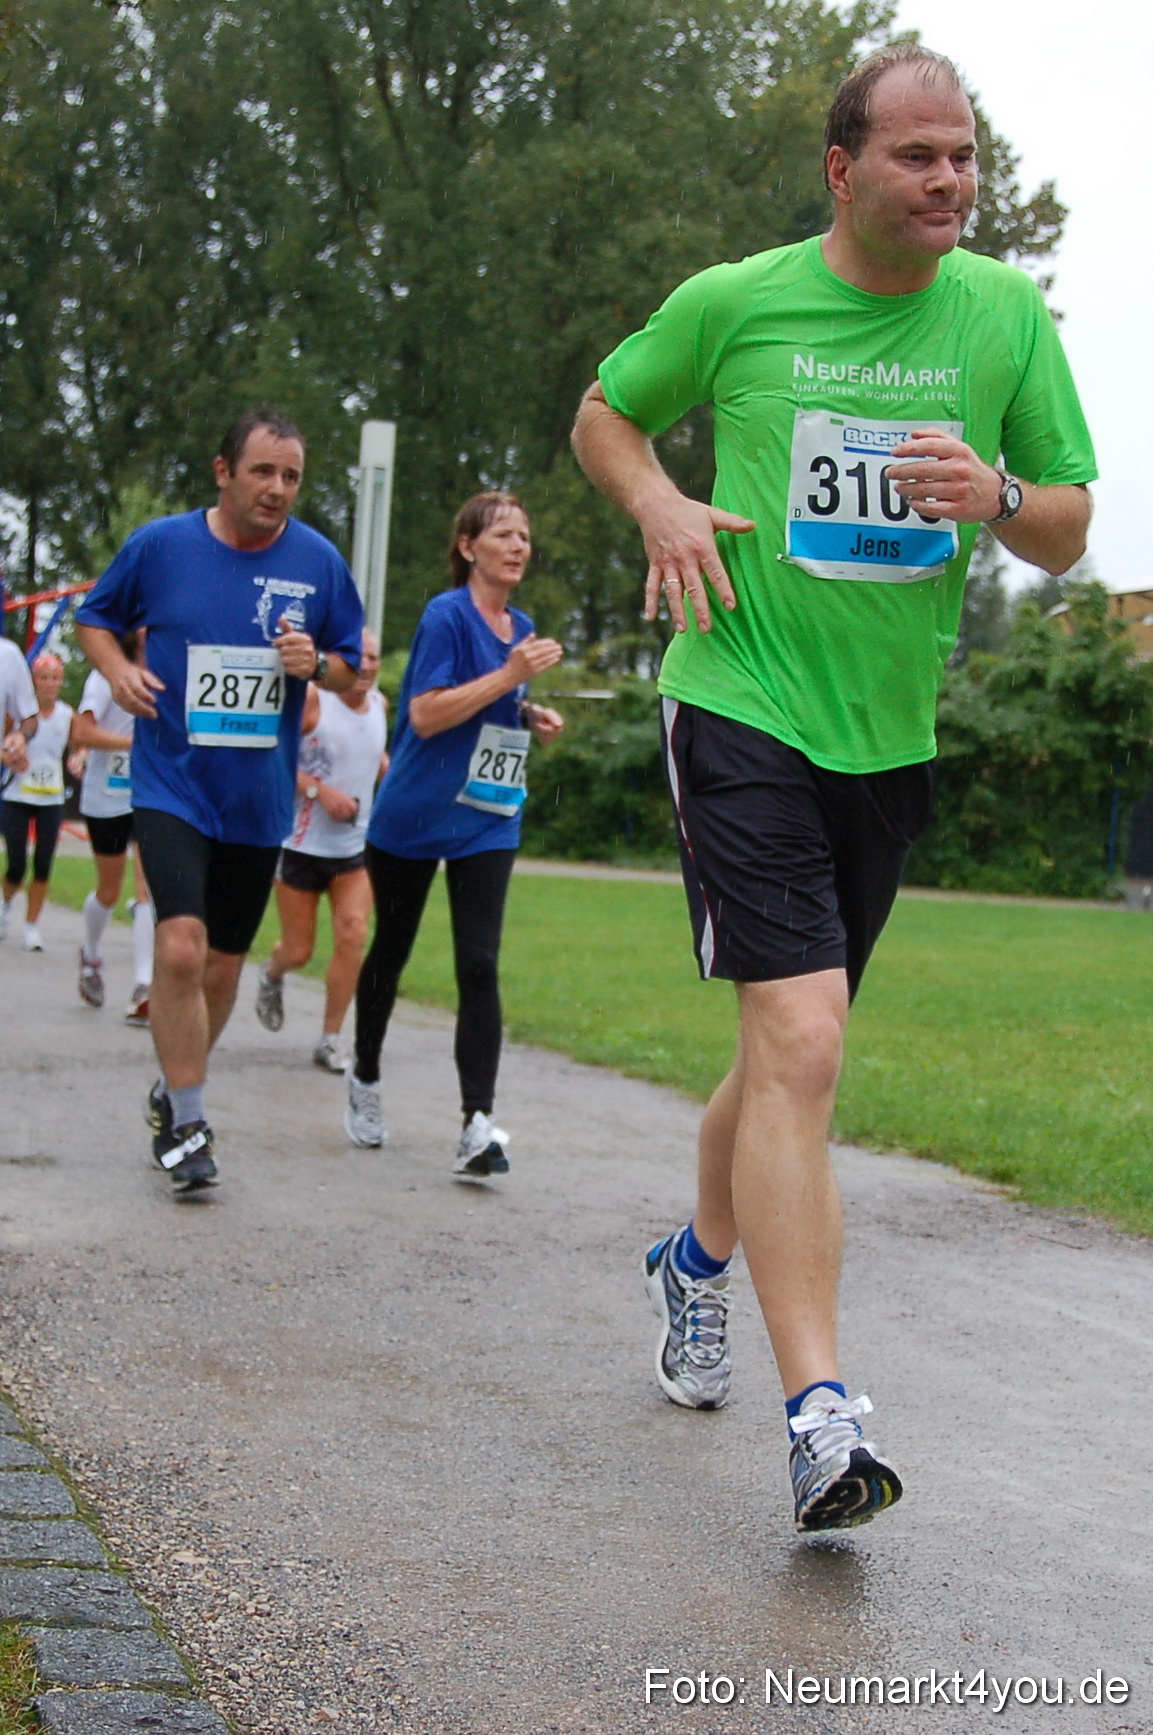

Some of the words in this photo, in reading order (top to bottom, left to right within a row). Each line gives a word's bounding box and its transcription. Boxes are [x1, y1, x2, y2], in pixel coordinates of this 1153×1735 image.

[843, 427, 908, 447] BOCK
[807, 455, 943, 525] 310
[794, 508, 801, 519] D
[850, 532, 901, 559] Jens
[198, 672, 282, 711] 2874
[220, 717, 259, 733] Franz
[477, 748, 523, 784] 287
